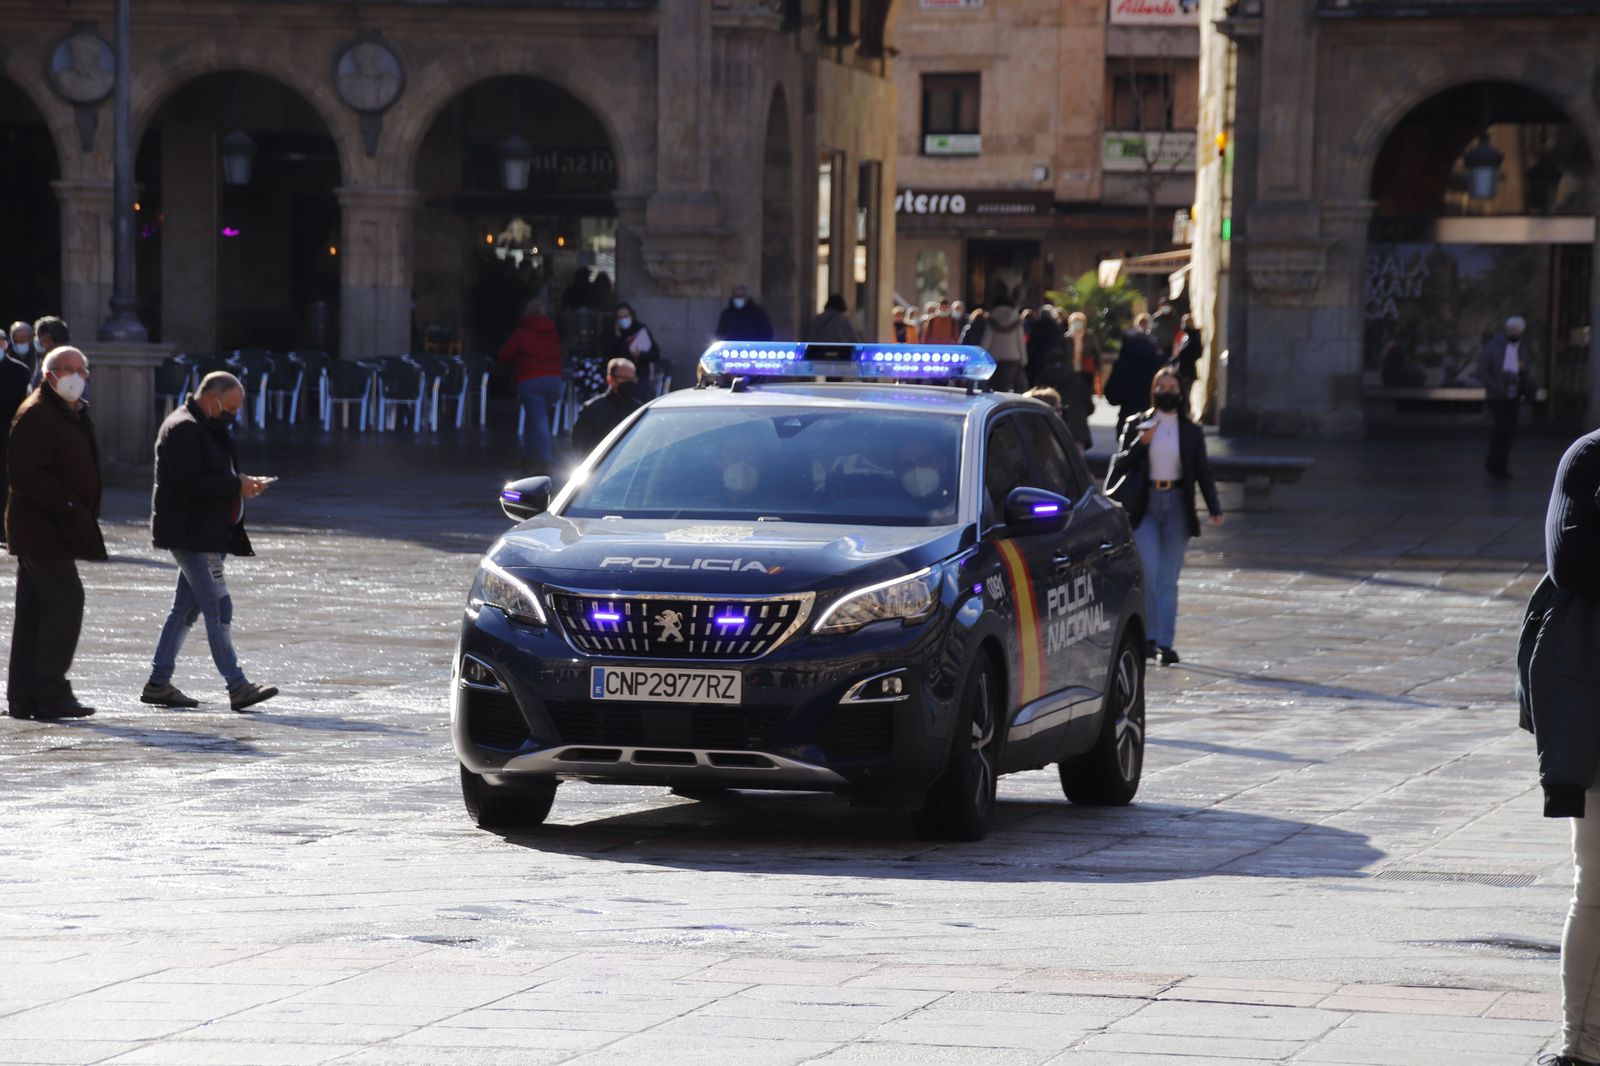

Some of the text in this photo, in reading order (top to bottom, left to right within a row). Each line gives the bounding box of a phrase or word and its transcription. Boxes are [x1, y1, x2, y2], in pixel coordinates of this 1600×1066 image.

[599, 555, 768, 574] POLICÍA
[1047, 602, 1111, 656] NACIONAL
[606, 671, 736, 699] CNP2977RZ
